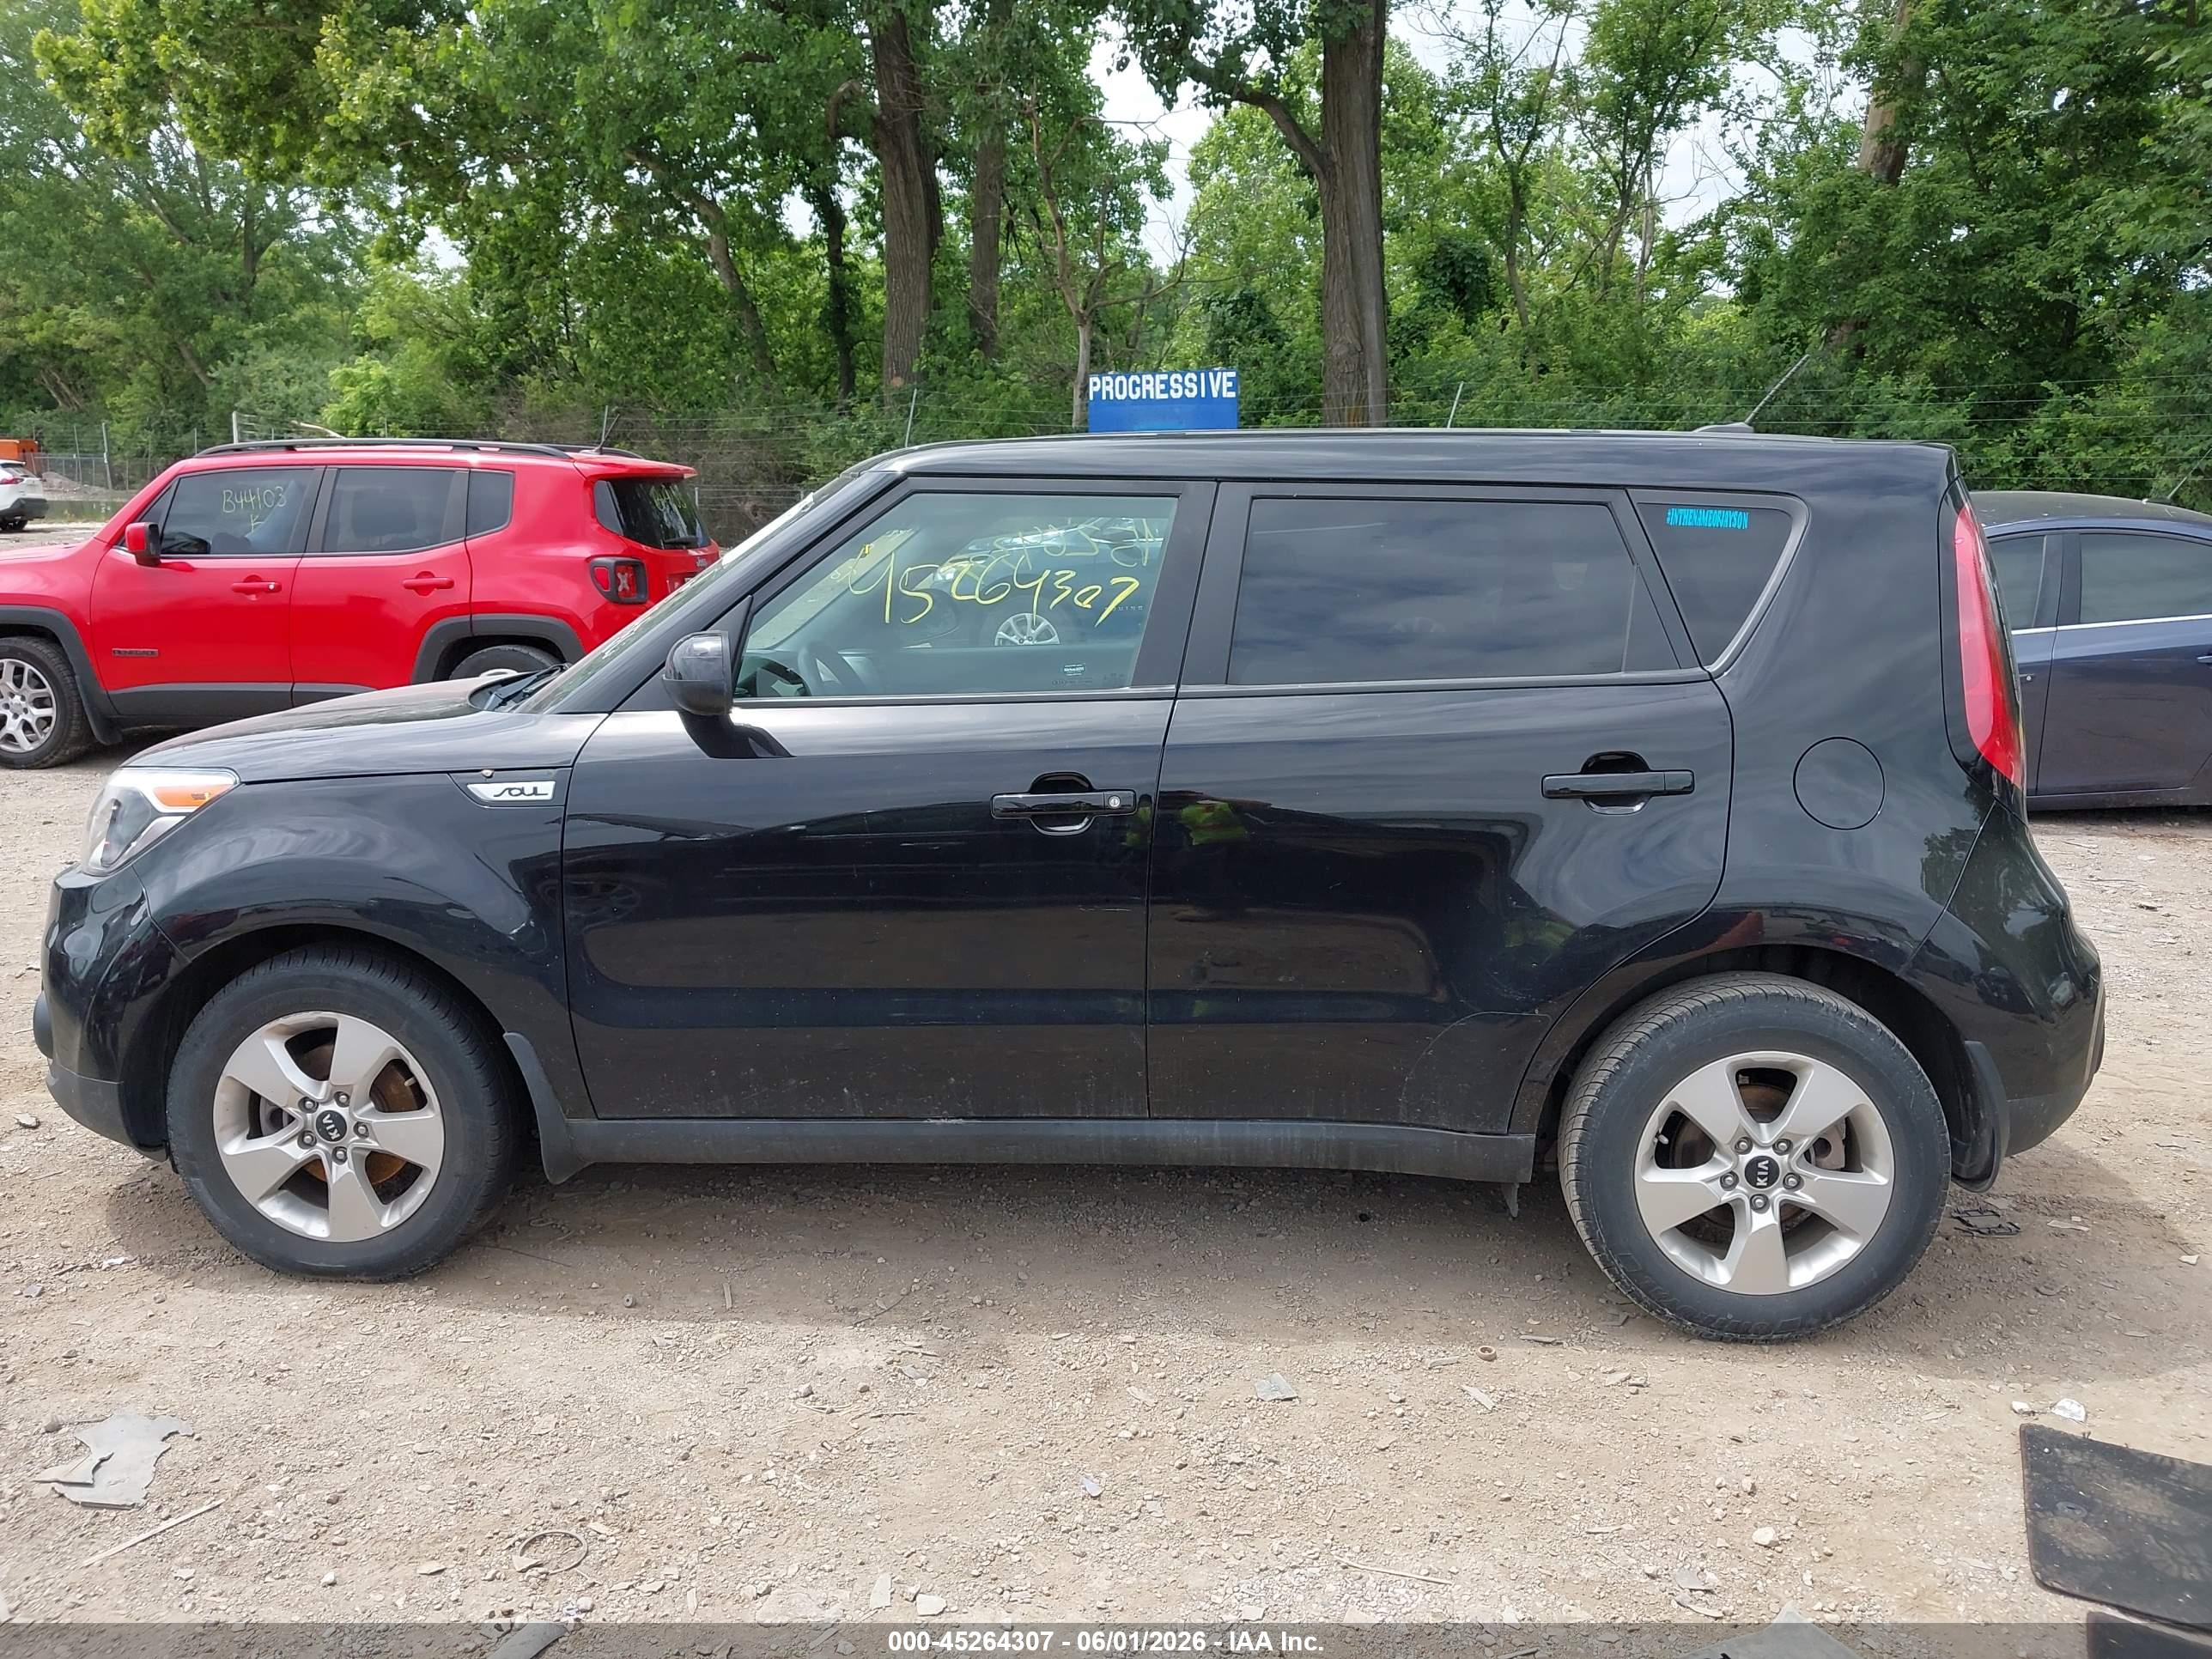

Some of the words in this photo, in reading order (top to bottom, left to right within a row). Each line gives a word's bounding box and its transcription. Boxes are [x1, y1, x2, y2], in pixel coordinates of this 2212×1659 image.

[1089, 371, 1237, 401] PROGRESSIVE
[222, 486, 287, 513] B44103
[848, 544, 1139, 628] 45264307
[322, 1113, 341, 1140] KIA
[1756, 1160, 1770, 1187] KIA
